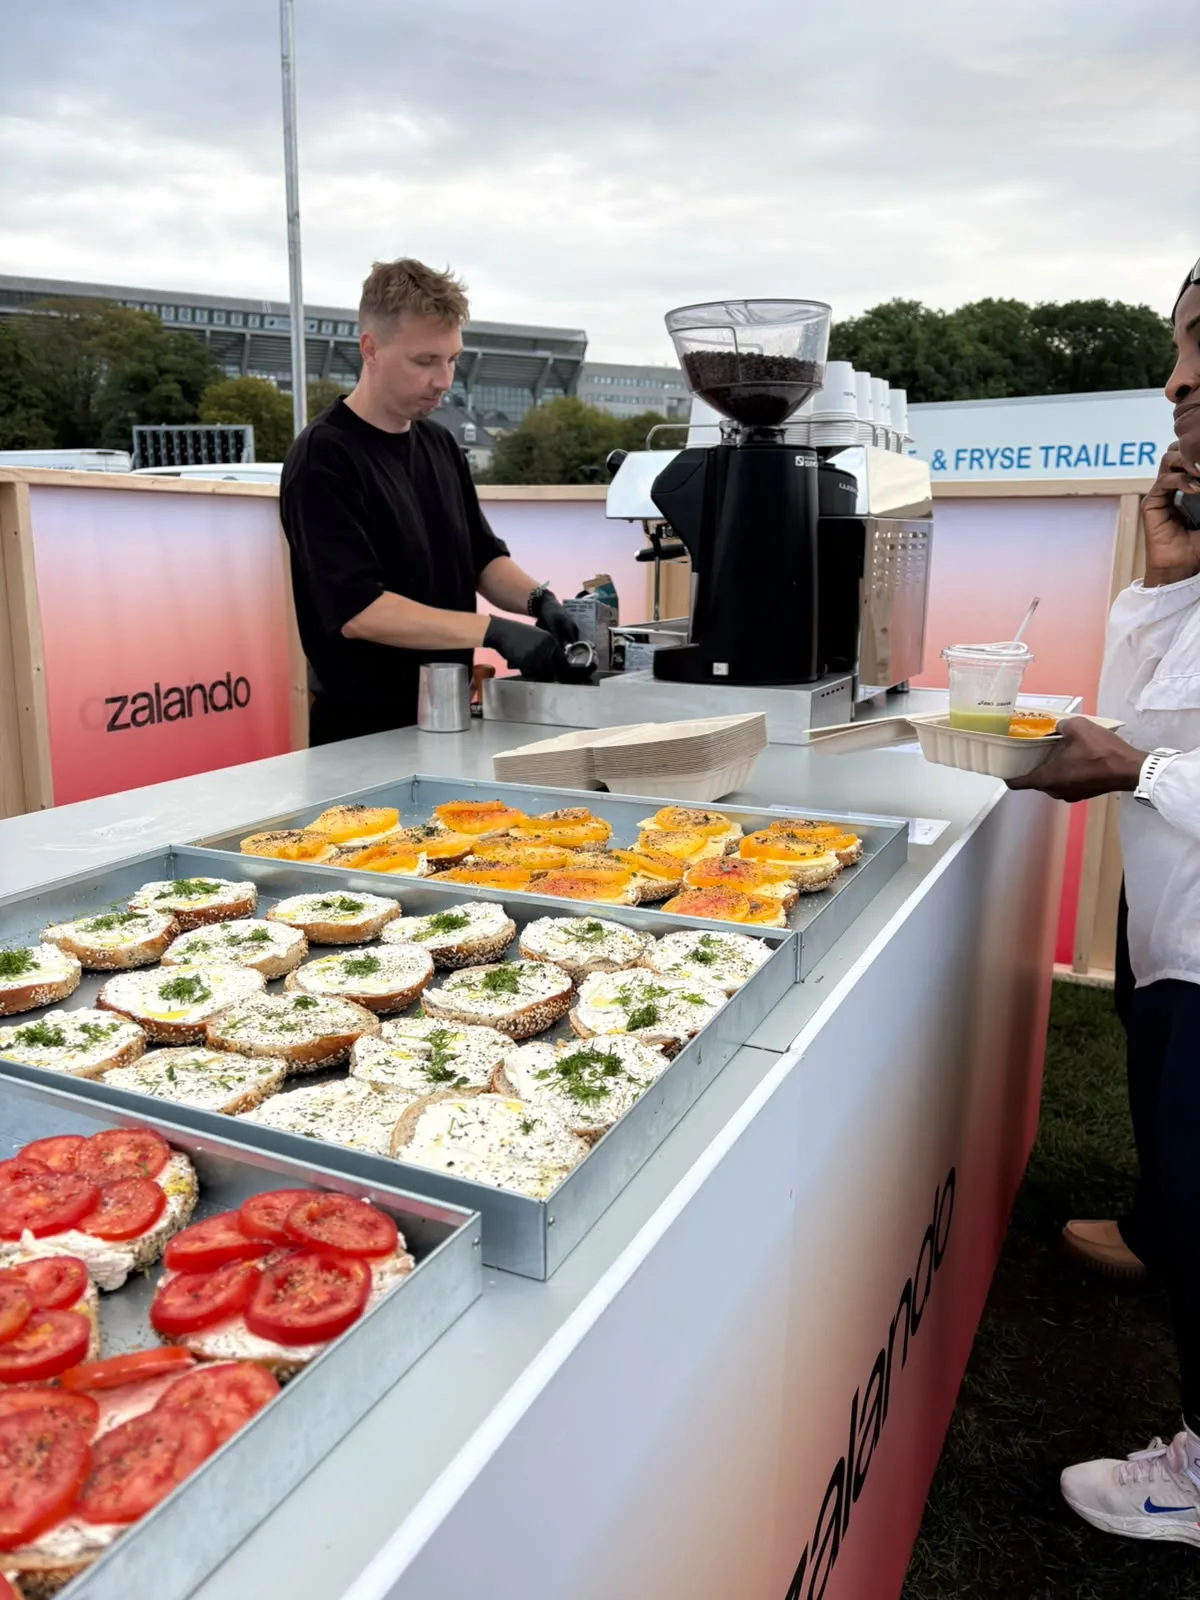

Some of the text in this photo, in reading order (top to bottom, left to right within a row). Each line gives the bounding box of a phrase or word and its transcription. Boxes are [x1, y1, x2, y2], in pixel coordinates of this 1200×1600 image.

[931, 441, 1156, 471] & FRYSE TRAILER
[105, 671, 251, 732] zalando
